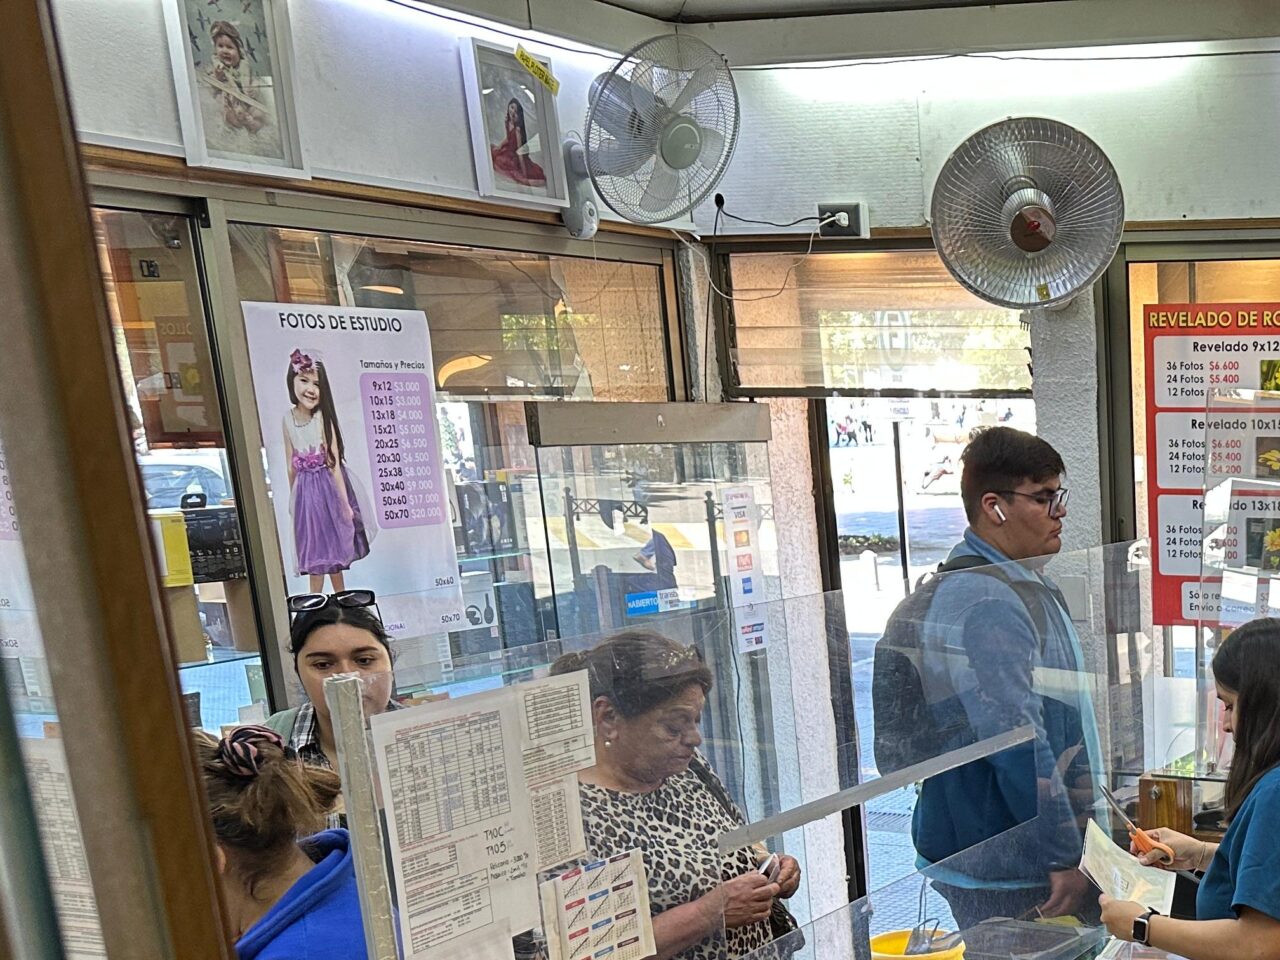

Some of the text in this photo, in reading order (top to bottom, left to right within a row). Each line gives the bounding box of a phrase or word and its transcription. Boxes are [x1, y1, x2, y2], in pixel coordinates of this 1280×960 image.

[279, 312, 403, 333] FOTOS DE ESTUDIO
[1149, 310, 1233, 328] REVELADO
[1237, 310, 1258, 327] DE
[1192, 340, 1280, 353] Revelado 9x12
[360, 359, 393, 369] Tamaños
[400, 360, 425, 370] Precios
[1166, 360, 1240, 372] 36 Fotos $6.600
[1166, 374, 1240, 385] 24 Fotos $5.400
[372, 380, 393, 391] 9x12
[1167, 387, 1178, 397] 12
[1180, 387, 1205, 397] Fotos
[369, 395, 394, 406] 10x15
[371, 409, 396, 420] 13x18
[373, 424, 396, 435] 15x21
[1191, 418, 1247, 430] Revelado
[375, 438, 399, 449] 20x25
[1168, 439, 1242, 450] 36 Fotos $6.600
[376, 453, 401, 463] 20x30
[1168, 451, 1242, 462] 24 Fotos $5.400
[378, 467, 403, 478] 25x38
[1169, 464, 1242, 475] 12 Fotos $4.200
[380, 481, 405, 492] 30x40
[382, 495, 407, 506] 50x60
[384, 509, 410, 520] 50x70
[1165, 525, 1177, 535] 36
[1179, 525, 1203, 535] Fotos
[1165, 538, 1177, 547] 24
[1179, 537, 1203, 547] Fotos
[1166, 550, 1177, 559] 12
[1179, 549, 1203, 559] Fotos
[435, 576, 455, 587] 50x60
[441, 613, 460, 624] 50x70
